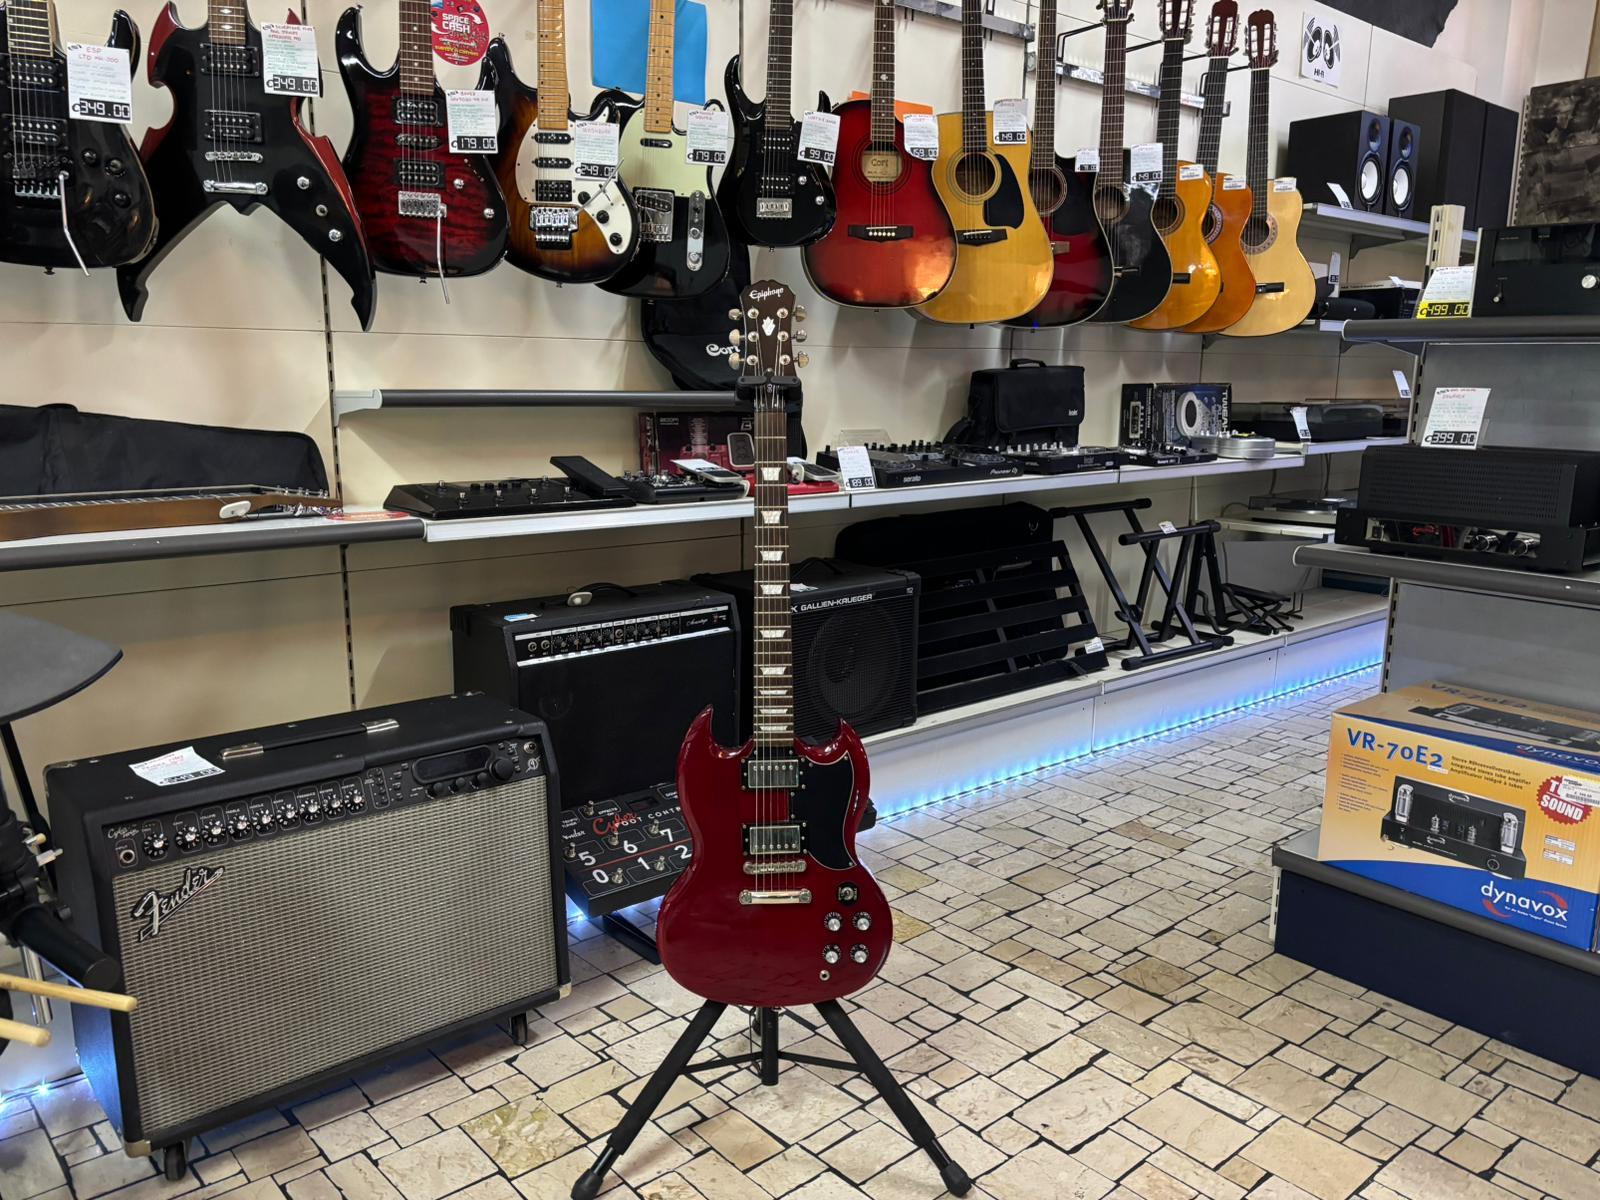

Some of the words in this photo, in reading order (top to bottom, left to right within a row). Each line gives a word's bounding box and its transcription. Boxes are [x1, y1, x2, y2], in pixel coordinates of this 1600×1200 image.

[442, 13, 469, 24] SPACE
[442, 21, 470, 34] CASH
[749, 287, 784, 302] Epiphone
[801, 594, 873, 611] GALLIEN-KRUEGER
[1347, 728, 1443, 768] VR-70E2
[1516, 745, 1600, 766] dynavo
[1541, 794, 1584, 821] SOUND
[659, 828, 673, 842] 7
[623, 840, 638, 854] 6
[674, 845, 692, 859] 2
[578, 851, 596, 866] 5
[637, 856, 650, 870] 1
[592, 869, 609, 883] 0
[131, 868, 217, 939] Fender
[1481, 880, 1568, 921] dynavox
